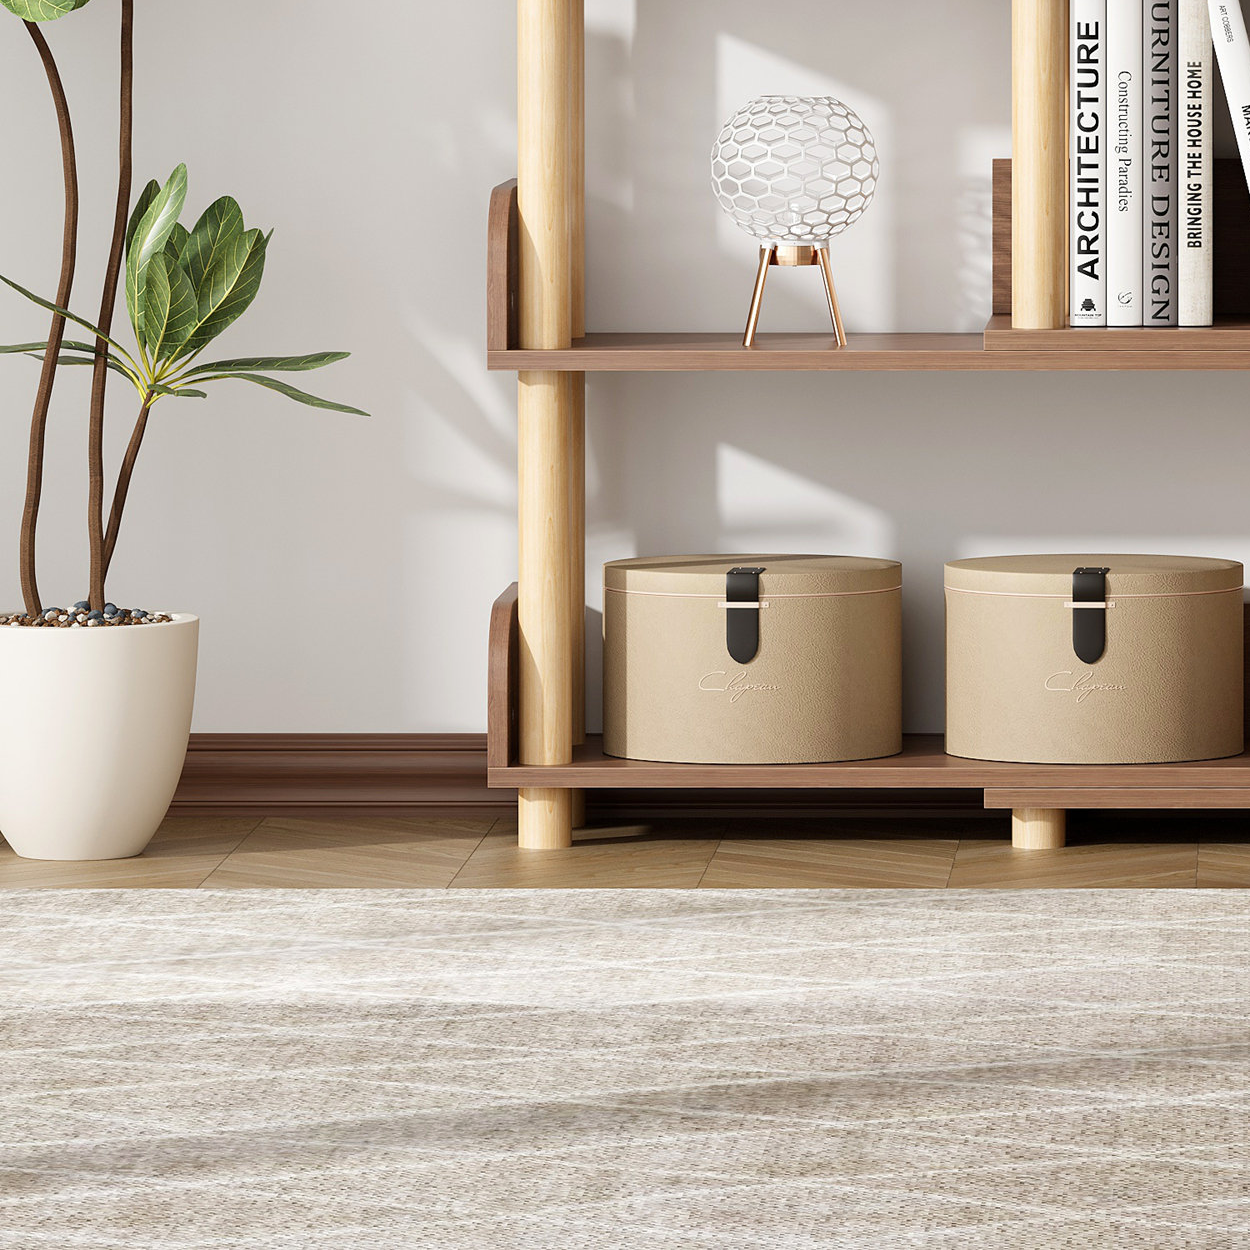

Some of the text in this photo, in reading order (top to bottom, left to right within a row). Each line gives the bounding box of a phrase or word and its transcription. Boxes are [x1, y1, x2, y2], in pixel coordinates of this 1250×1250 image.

[1218, 4, 1228, 17] ART
[1077, 21, 1099, 281] ARCHITECTURE
[1114, 70, 1132, 213] Constructing Paradies
[1187, 60, 1203, 249] BRINGING THE HOUSE HOME
[1151, 195, 1171, 322] DESIGN
